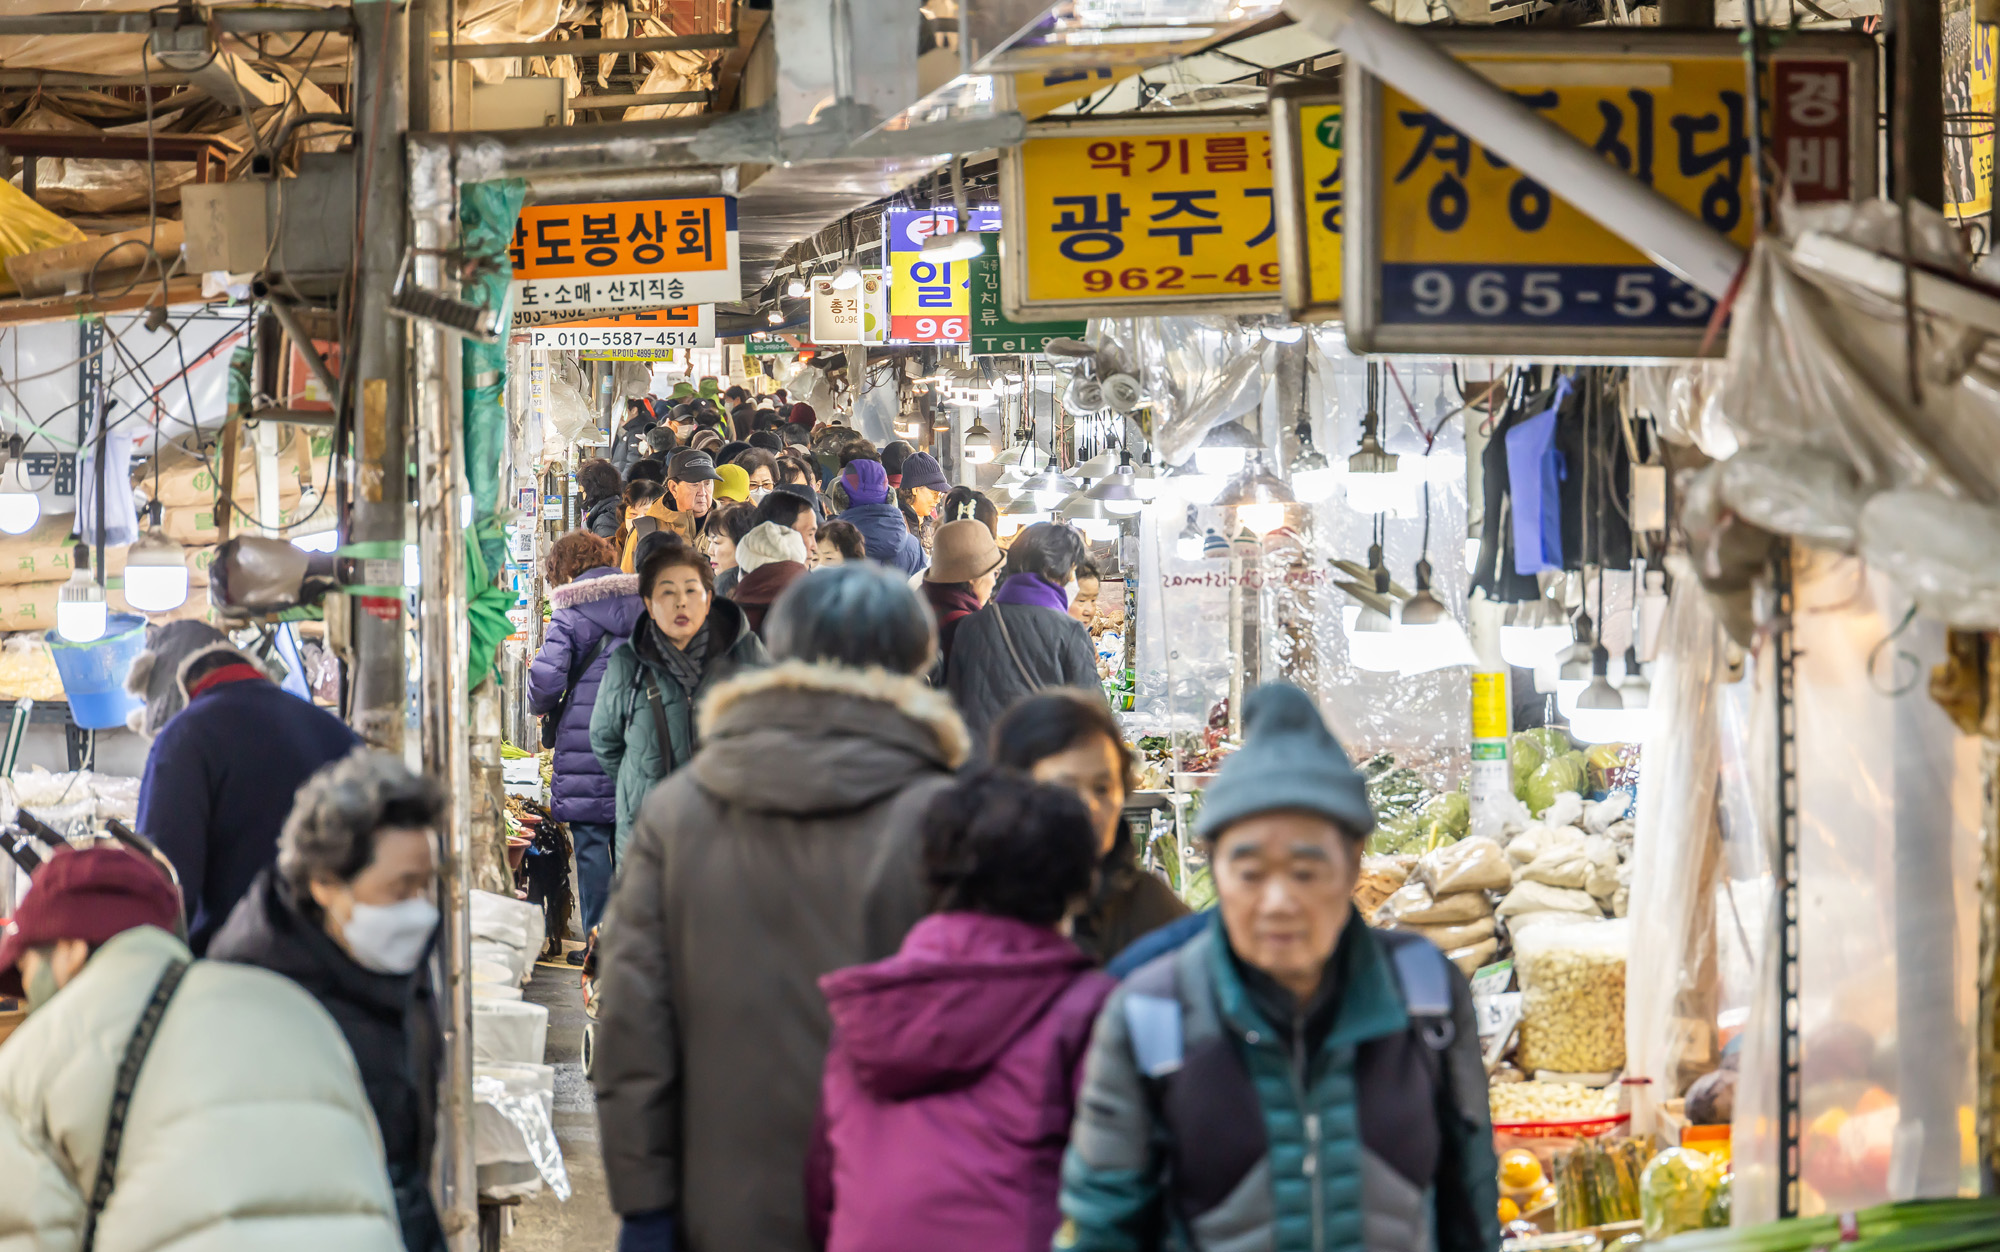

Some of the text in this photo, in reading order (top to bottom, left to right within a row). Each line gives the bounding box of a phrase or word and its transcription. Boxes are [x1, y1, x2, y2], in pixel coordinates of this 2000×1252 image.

[1086, 137, 1272, 177] 약기름
[909, 261, 969, 308] 일
[1082, 263, 1281, 293] 962-49
[915, 318, 964, 338] 96
